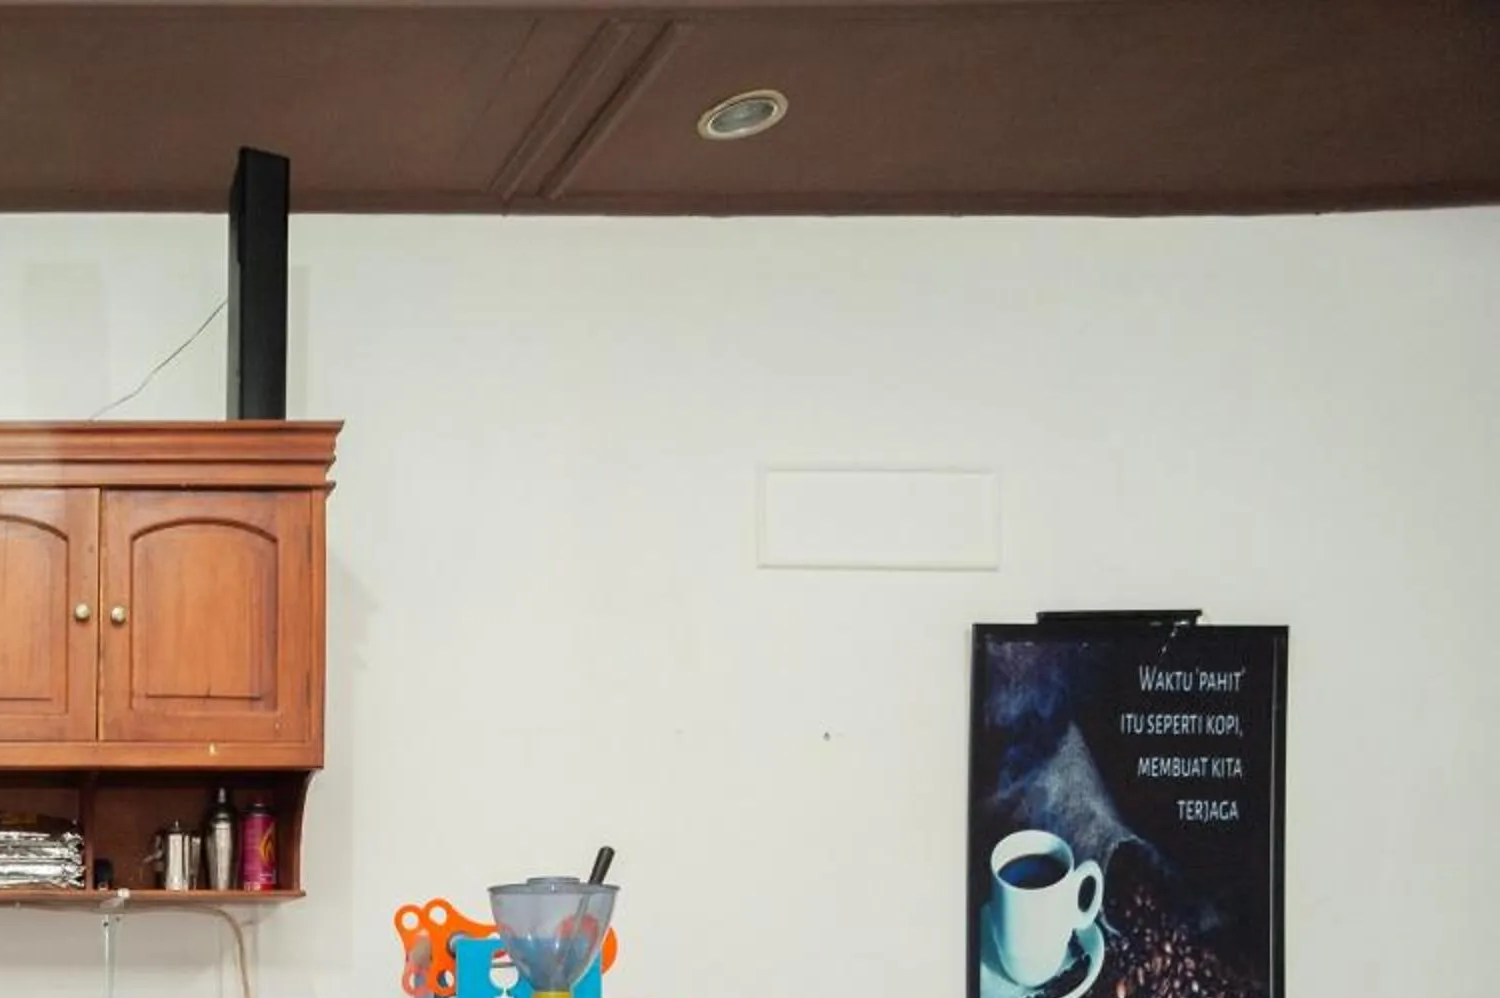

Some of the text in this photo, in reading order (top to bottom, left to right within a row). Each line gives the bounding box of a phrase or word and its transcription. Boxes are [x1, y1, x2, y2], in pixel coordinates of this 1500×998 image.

[1138, 665, 1193, 691] WAKTU
[1120, 713, 1243, 739] ITU SEPERTI KOPI,
[1137, 757, 1243, 778] MEMBUAT KITA
[1176, 801, 1240, 822] TERJAGA
